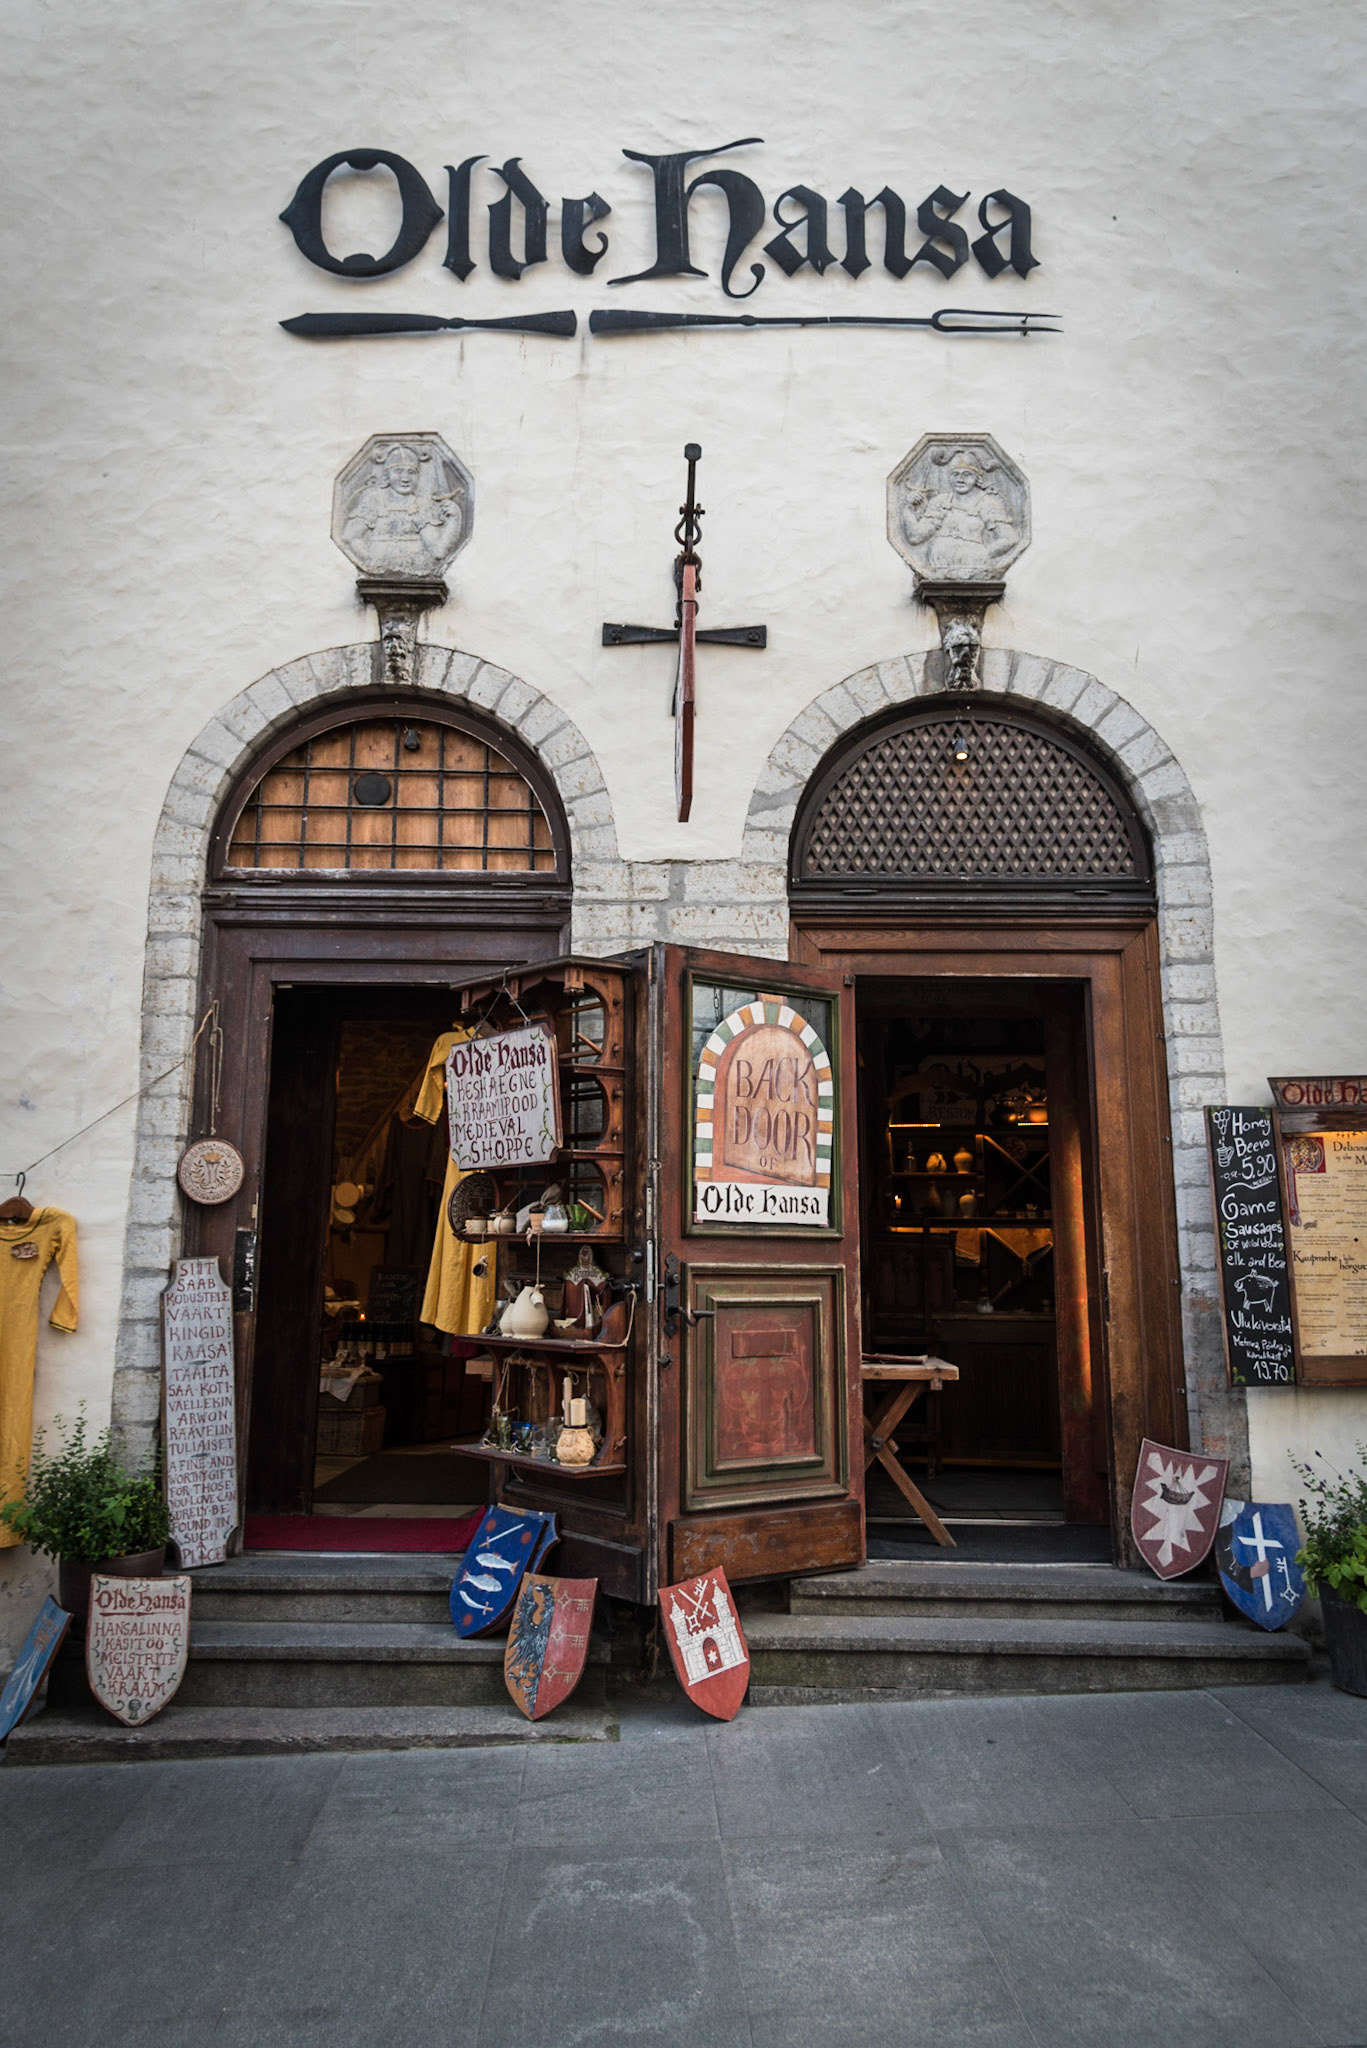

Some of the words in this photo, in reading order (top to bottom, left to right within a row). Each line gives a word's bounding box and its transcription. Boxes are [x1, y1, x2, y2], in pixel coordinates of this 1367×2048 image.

[278, 148, 612, 281] Olde
[606, 137, 1042, 299] Hansa
[450, 1044, 492, 1077] Olde
[735, 1057, 816, 1107] BACK
[1282, 1083, 1332, 1105] Olde
[454, 1117, 526, 1144] MEDIEVAL
[1232, 1112, 1271, 1136] Honey
[733, 1105, 814, 1167] DOOR
[471, 1137, 534, 1163] SHOPPE
[1234, 1137, 1270, 1157] Beer
[759, 1155, 777, 1170] OF
[1241, 1153, 1276, 1180] 5.90
[700, 1183, 754, 1214] Olde
[1221, 1192, 1276, 1220] Game
[1225, 1222, 1283, 1243] Sausages
[180, 1262, 215, 1277] SIIT
[1226, 1251, 1246, 1266] elk
[1247, 1253, 1267, 1268] and
[1267, 1252, 1286, 1269] Bear
[177, 1278, 216, 1292] SAAB
[169, 1325, 225, 1342] KINGID
[179, 1456, 205, 1471] FINE
[210, 1455, 234, 1468] AND
[168, 1470, 207, 1485] WORTHY
[208, 1468, 235, 1480] GIFT
[169, 1486, 190, 1498] FOR
[193, 1481, 232, 1495] THOSE
[168, 1498, 188, 1510] YOU
[189, 1494, 216, 1506] LOVE
[216, 1490, 237, 1503] CAN
[211, 1503, 230, 1515] BE
[171, 1517, 212, 1534] FOUND
[183, 1529, 218, 1544] SUCH
[196, 1541, 207, 1550] A
[95, 1587, 135, 1610] Olde
[94, 1621, 182, 1637] HANSALINNA
[100, 1652, 178, 1666] MEISTRITE
[106, 1680, 166, 1697] KRAAM
